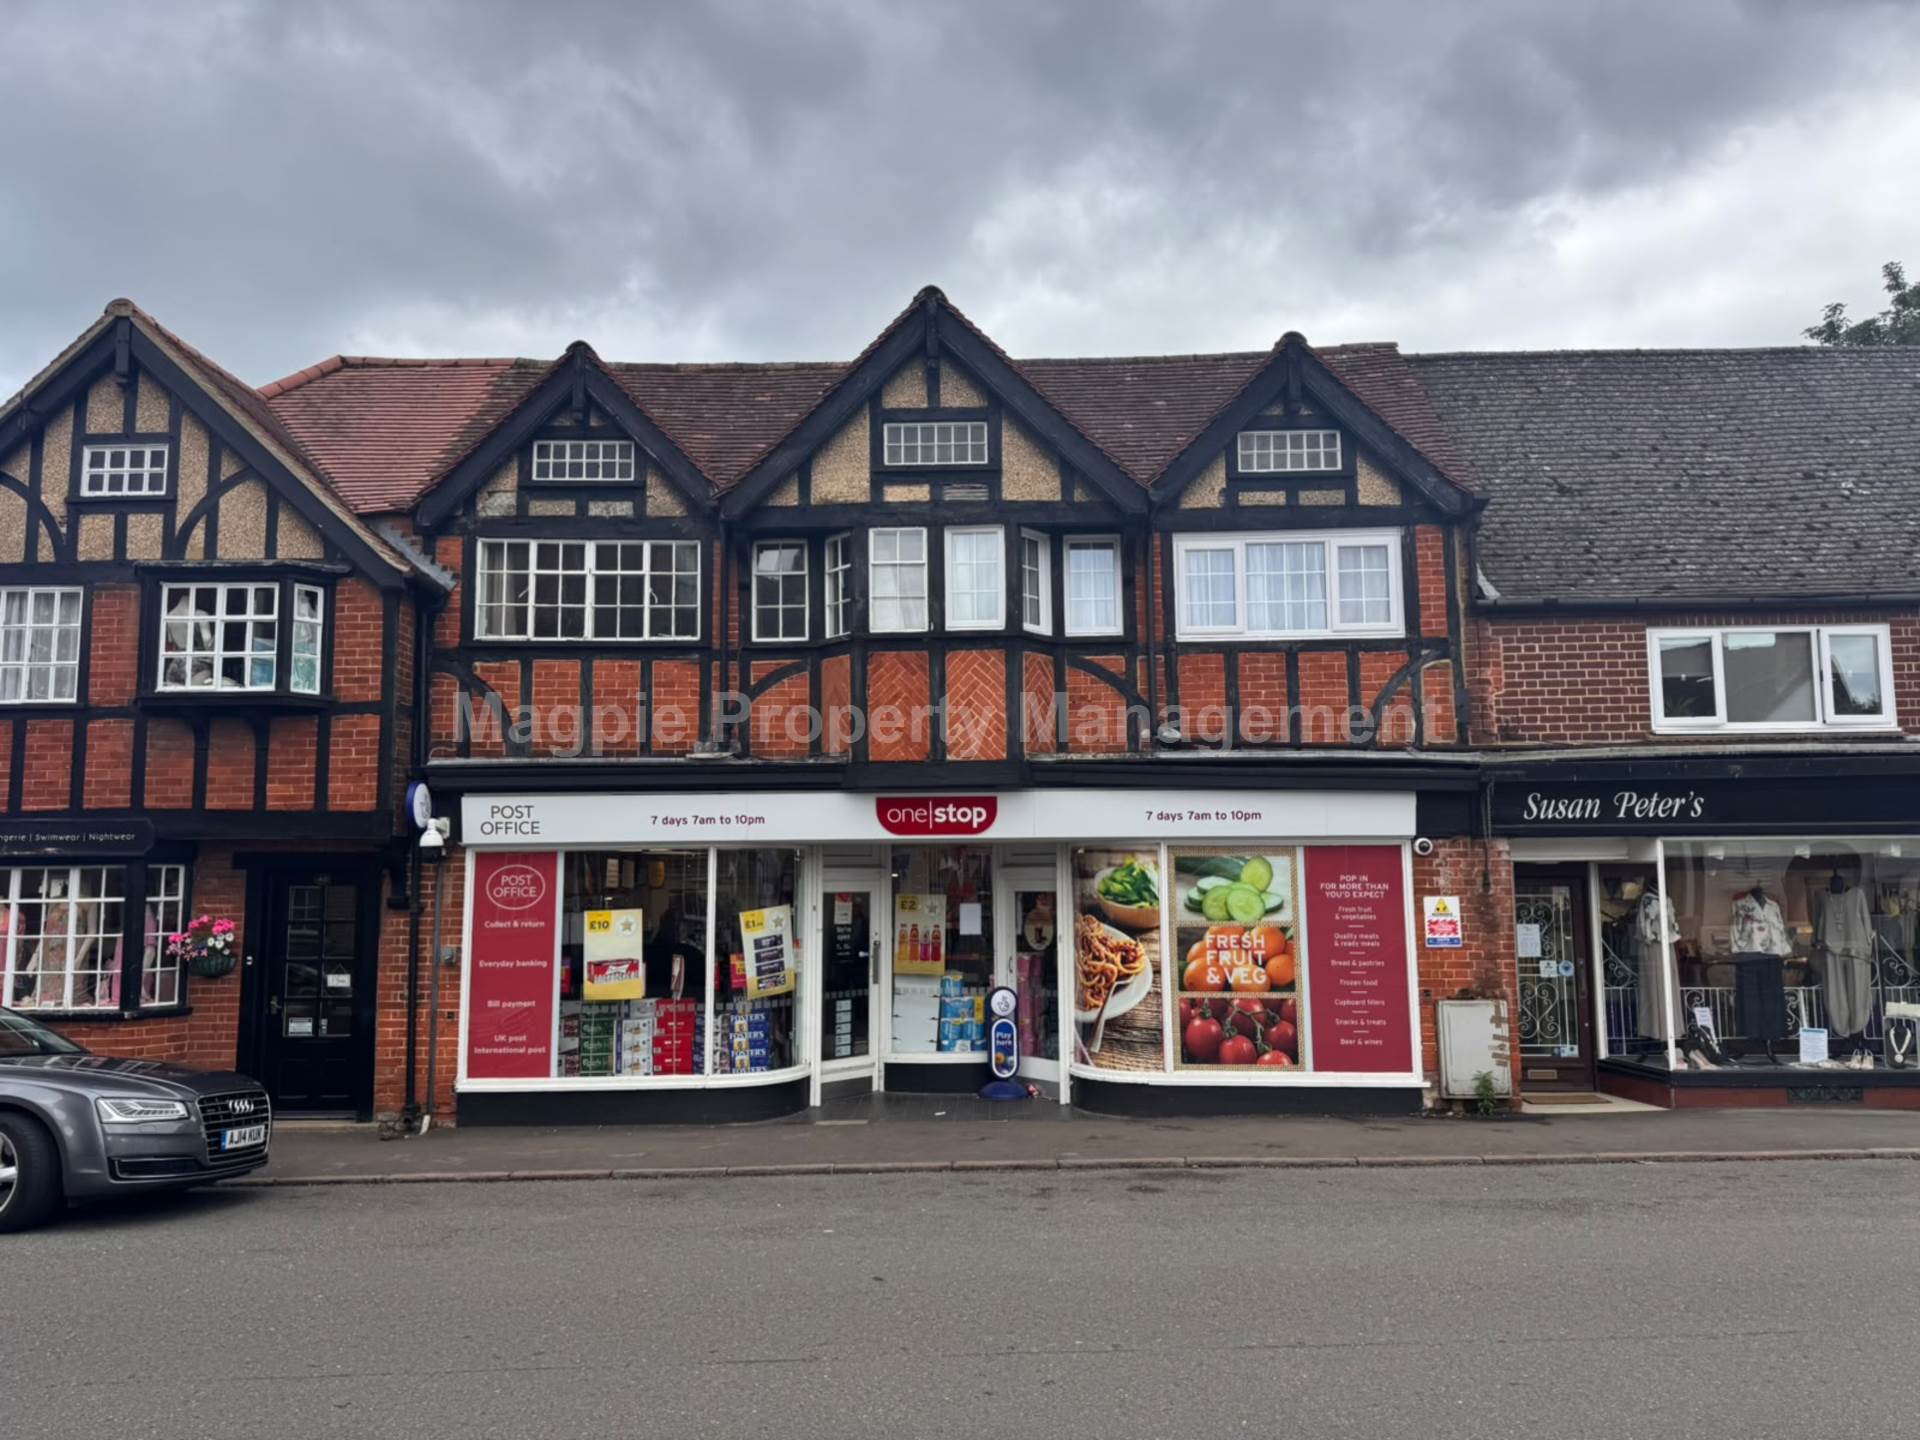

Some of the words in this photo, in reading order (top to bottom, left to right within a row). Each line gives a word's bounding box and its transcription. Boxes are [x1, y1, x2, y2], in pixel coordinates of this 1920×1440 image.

[1523, 792, 1600, 820] Susan
[1613, 791, 1704, 818] Peter's
[490, 805, 535, 819] POST
[887, 808, 928, 823] one
[934, 803, 987, 829] stop
[1145, 811, 1153, 821] 7
[1156, 811, 1184, 822] days
[1187, 811, 1212, 821] 7am
[1215, 810, 1228, 821] to
[1231, 810, 1262, 822] 10pm
[650, 815, 658, 825] 7
[661, 816, 688, 827] days
[692, 815, 716, 825] 7am
[719, 815, 732, 825] to
[735, 815, 766, 826] 10pm
[480, 821, 541, 836] OFFICE
[35, 833, 80, 841] Swimwear
[88, 832, 136, 842] Nightwear
[501, 874, 532, 886] POST
[493, 886, 537, 898] OFFICE
[900, 901, 917, 910] £2
[590, 921, 610, 930] £10
[1206, 934, 1265, 949] FRESH
[1334, 932, 1357, 940] Quality
[480, 960, 514, 968] Everyday
[516, 960, 548, 968] banking
[1207, 950, 1266, 966] FRUIT
[1207, 967, 1221, 984] &
[1223, 967, 1267, 984] VEG
[502, 1000, 536, 1008] payment
[996, 1032, 1011, 1040] Play
